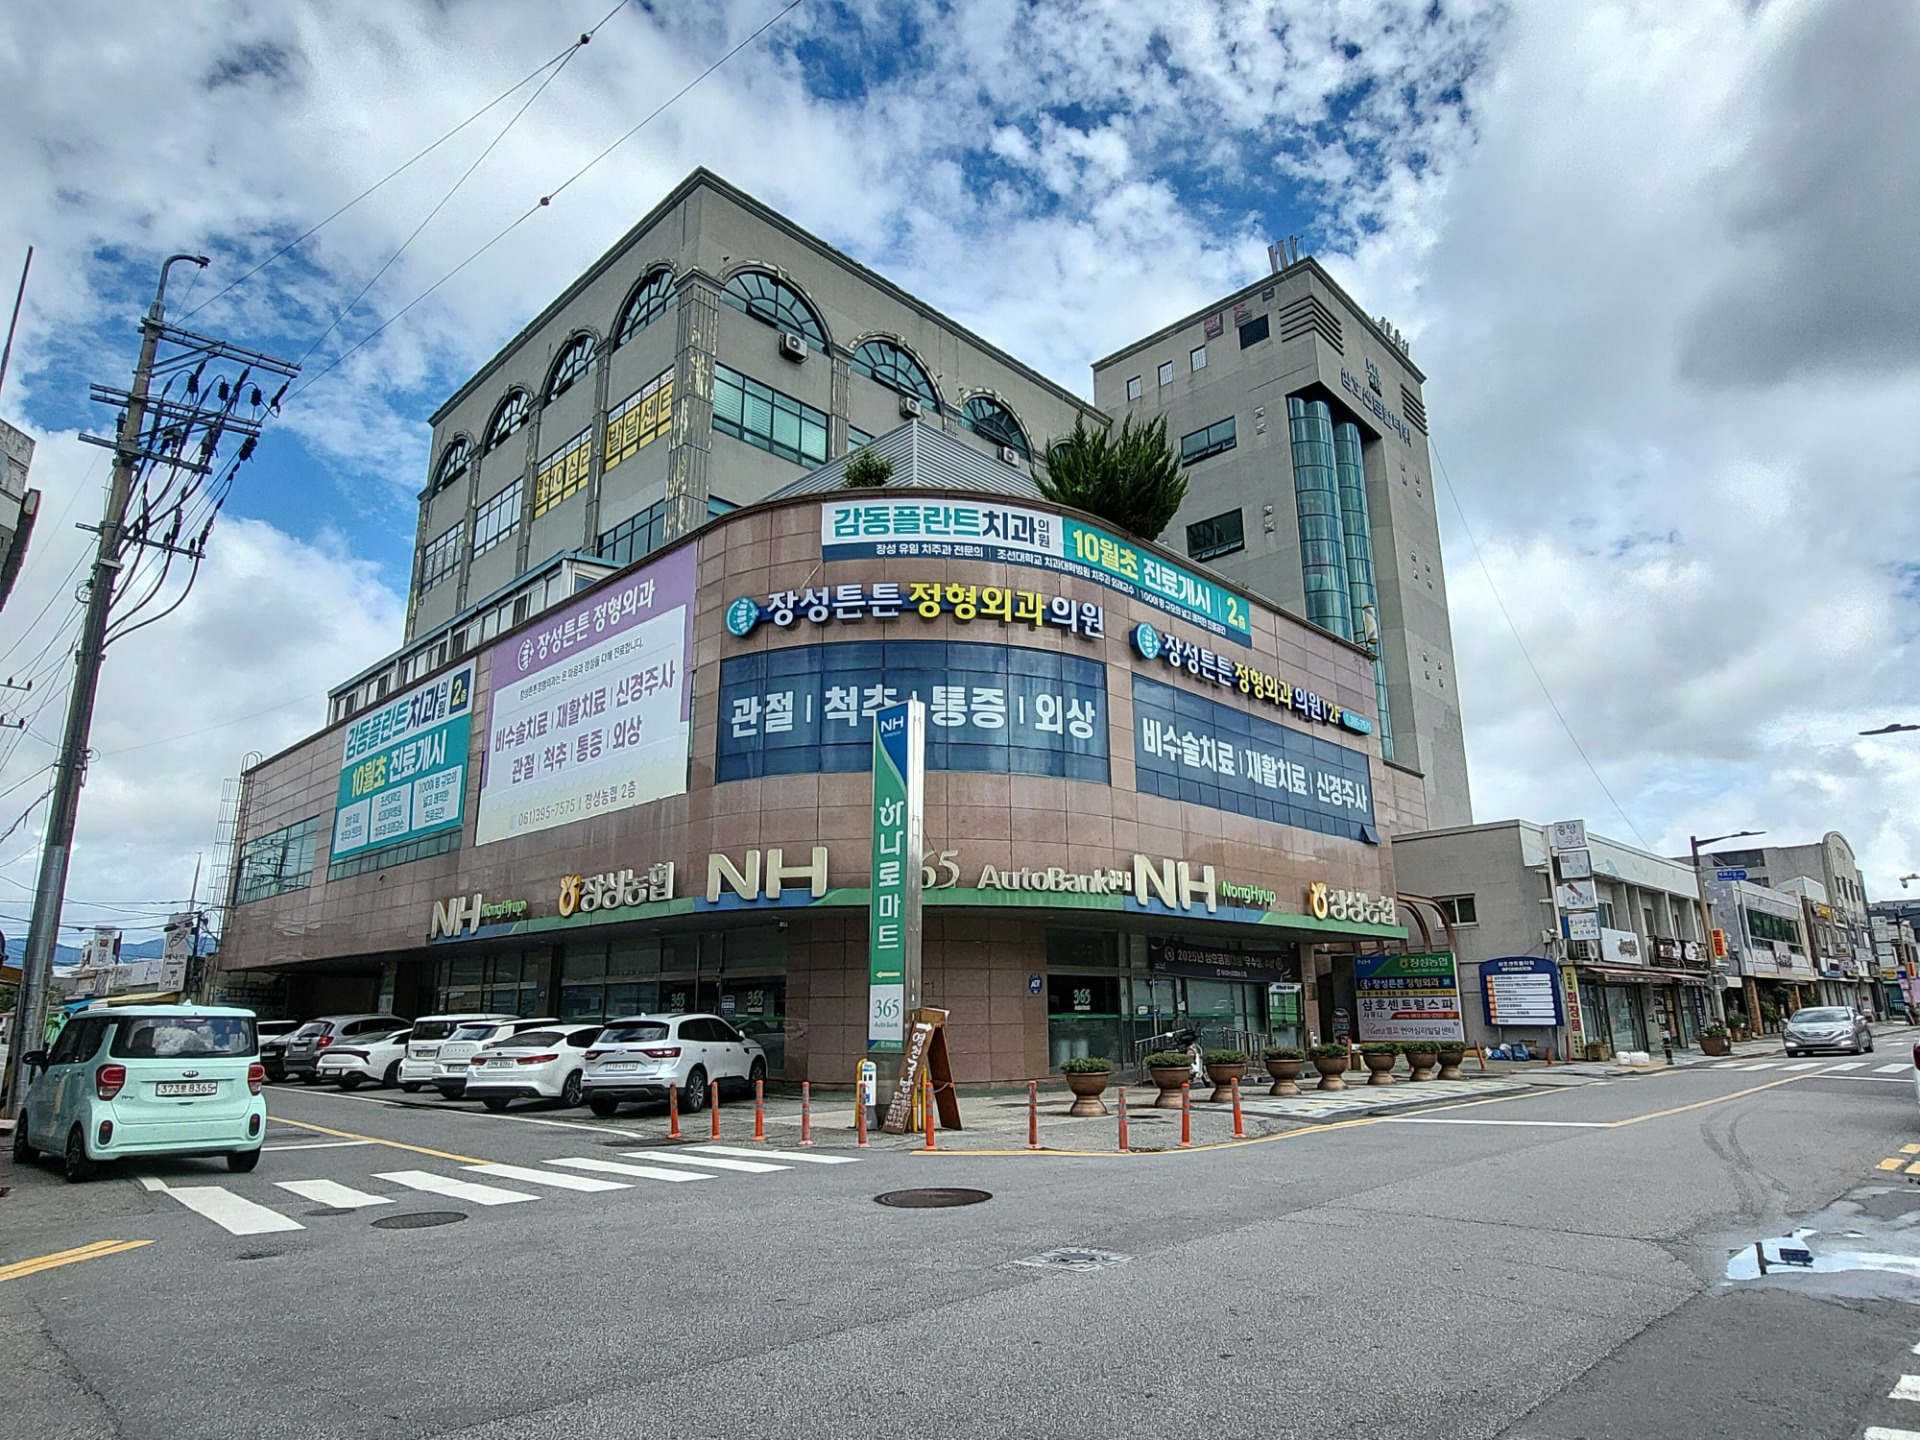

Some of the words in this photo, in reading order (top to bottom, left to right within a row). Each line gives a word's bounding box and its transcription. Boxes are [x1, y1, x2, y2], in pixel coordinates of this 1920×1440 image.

[876, 543, 896, 556] 장성
[898, 543, 919, 555] 유일
[921, 544, 951, 556] 치주과
[954, 545, 984, 558] 전문의
[997, 549, 1043, 566] 조선대학교
[1073, 529, 1139, 581] 10월초
[1143, 557, 1211, 615] 진료개시
[1226, 596, 1246, 631] 2층
[537, 611, 590, 660] 장성튼튼
[593, 578, 655, 633] 정형외과
[452, 678, 467, 707] 2층
[495, 710, 548, 754] 비수술치료
[556, 686, 607, 732] 재활치료
[616, 659, 676, 709] 신경주사
[731, 691, 794, 738] 관절
[824, 685, 898, 727] 척추
[930, 685, 1005, 728] 통증
[1034, 694, 1095, 740] 외상
[880, 715, 904, 733] NH
[1327, 705, 1342, 724] 2F
[352, 754, 388, 799] 10월초
[389, 728, 448, 784] 진료개시
[512, 752, 535, 784] 관절
[543, 741, 567, 773] 척추
[576, 729, 602, 763] 통증
[612, 715, 642, 751] 외상
[1142, 717, 1236, 777] 비수술치료
[1246, 749, 1307, 796] 재활치료
[1316, 771, 1367, 813] 신경주사
[518, 798, 575, 827] 061)395-7575
[585, 784, 618, 810] 장성농협
[621, 780, 636, 801] 2층
[581, 861, 675, 912] 장성농협
[706, 846, 828, 903] NH
[876, 797, 904, 950] 하나로마트
[922, 850, 961, 889] 65
[977, 864, 1110, 895] AutoBank
[1133, 853, 1217, 914] NH
[1219, 881, 1276, 906] NongHyup
[431, 893, 482, 940] NH
[481, 900, 527, 918] NongHyup
[1328, 888, 1397, 926] 장성농협
[1410, 956, 1448, 968] 장성농협
[671, 992, 686, 1007] 365
[747, 990, 764, 1006] 365
[1073, 988, 1091, 1004] 365
[1406, 977, 1440, 988] 정형외과
[874, 998, 900, 1019] 365
[1362, 998, 1454, 1011] 삼호센트럴스파
[1363, 1011, 1383, 1019] 사우나
[1567, 992, 1581, 1031] 화장품
